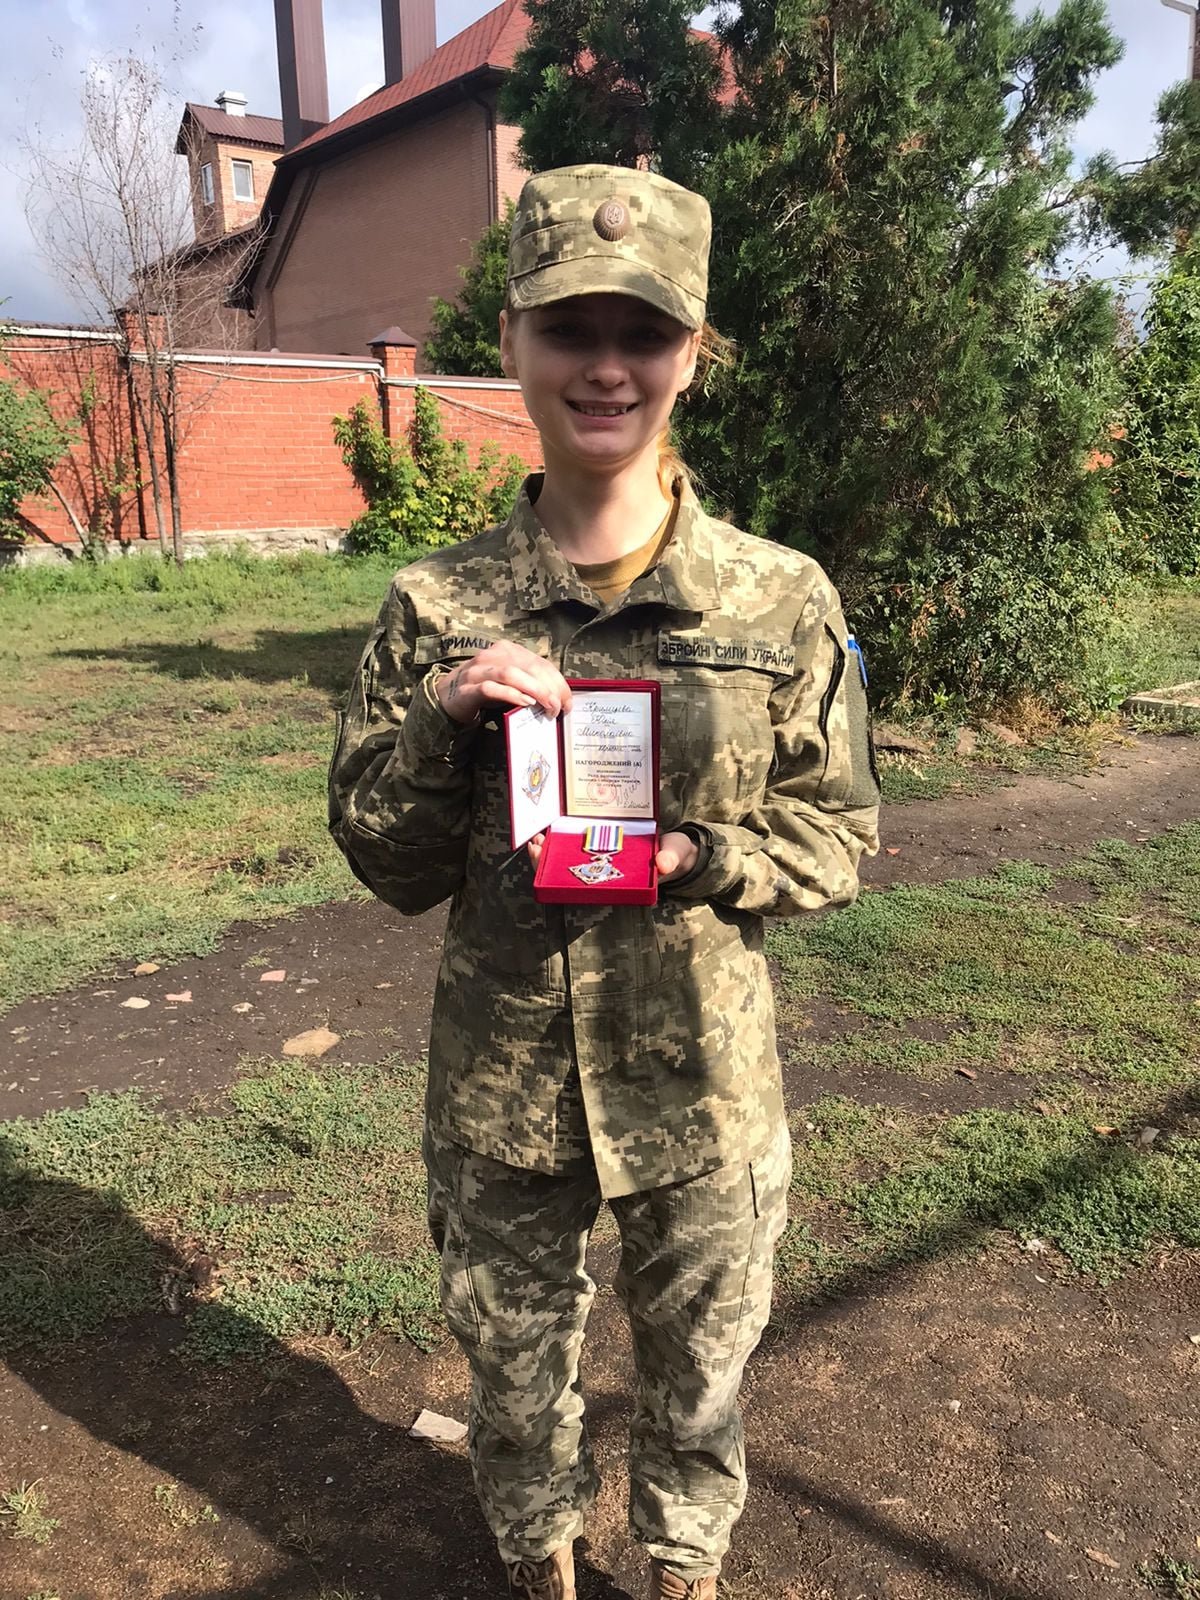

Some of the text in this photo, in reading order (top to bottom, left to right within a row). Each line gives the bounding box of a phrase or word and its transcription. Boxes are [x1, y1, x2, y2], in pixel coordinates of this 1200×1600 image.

[661, 641, 795, 669] ЗБРОЙНІ СИЛИ УКРАЇНИ
[575, 759, 632, 768] НАГОРОДЖЕНИЙ
